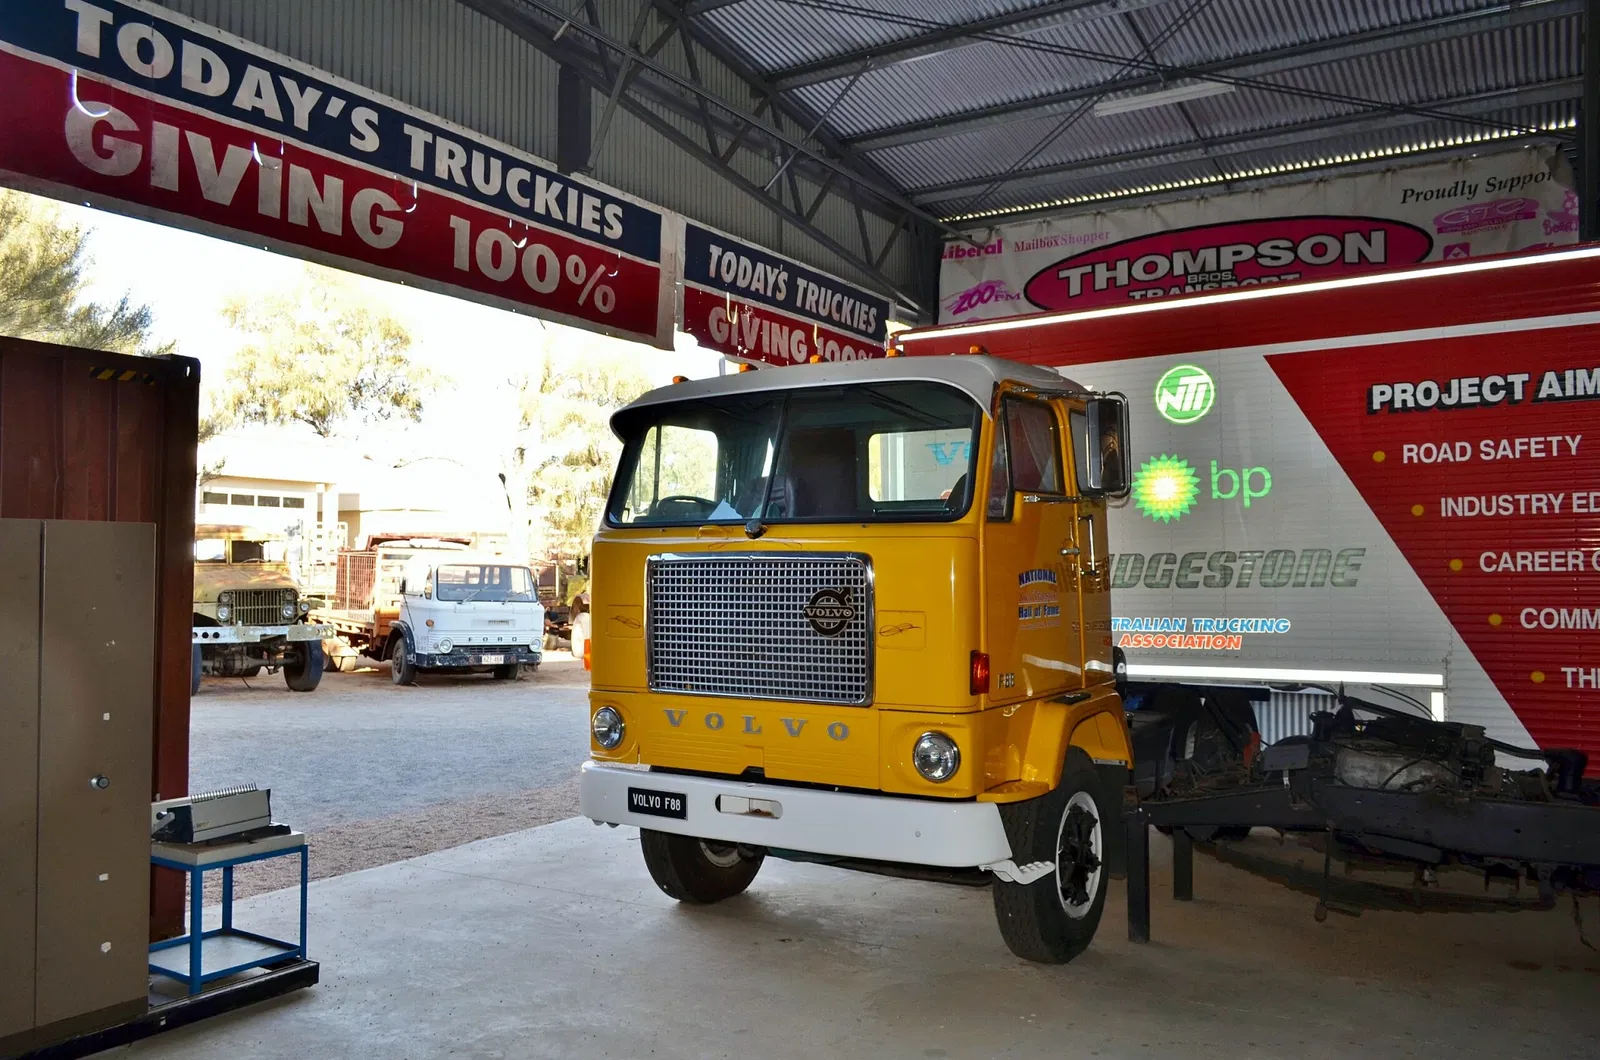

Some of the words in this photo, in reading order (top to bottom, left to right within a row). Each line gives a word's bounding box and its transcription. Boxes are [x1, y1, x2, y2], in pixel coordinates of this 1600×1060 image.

[64, 0, 381, 153] TODAY'S
[403, 123, 624, 240] TRUCKIES
[1400, 178, 1479, 205] Proudly
[64, 100, 405, 250] GIVING
[450, 214, 617, 314] 100%
[1058, 230, 1386, 297] THOMPSON
[708, 245, 788, 300] TODAY'S
[796, 277, 877, 334] TRUCKIES
[1187, 272, 1236, 284] BROS.
[708, 306, 808, 364] GIVING
[1371, 373, 1530, 411] PROJECT
[1403, 441, 1472, 464] ROAD
[1480, 434, 1582, 461] SAFETY
[1210, 459, 1273, 509] bp
[1441, 493, 1565, 517] INDUSTRY
[1479, 551, 1585, 573] CAREER
[1019, 569, 1057, 587] NATIONAL
[805, 608, 853, 617] VOLVO
[1018, 606, 1033, 620] Hall
[1043, 604, 1060, 617] Fame
[1192, 617, 1291, 633] TRUCKING
[1119, 634, 1242, 650] ASSOCIATION
[1560, 667, 1600, 689] TH
[663, 708, 850, 741] VOLVO
[632, 793, 661, 809] VOLVO
[665, 798, 681, 812] F88
